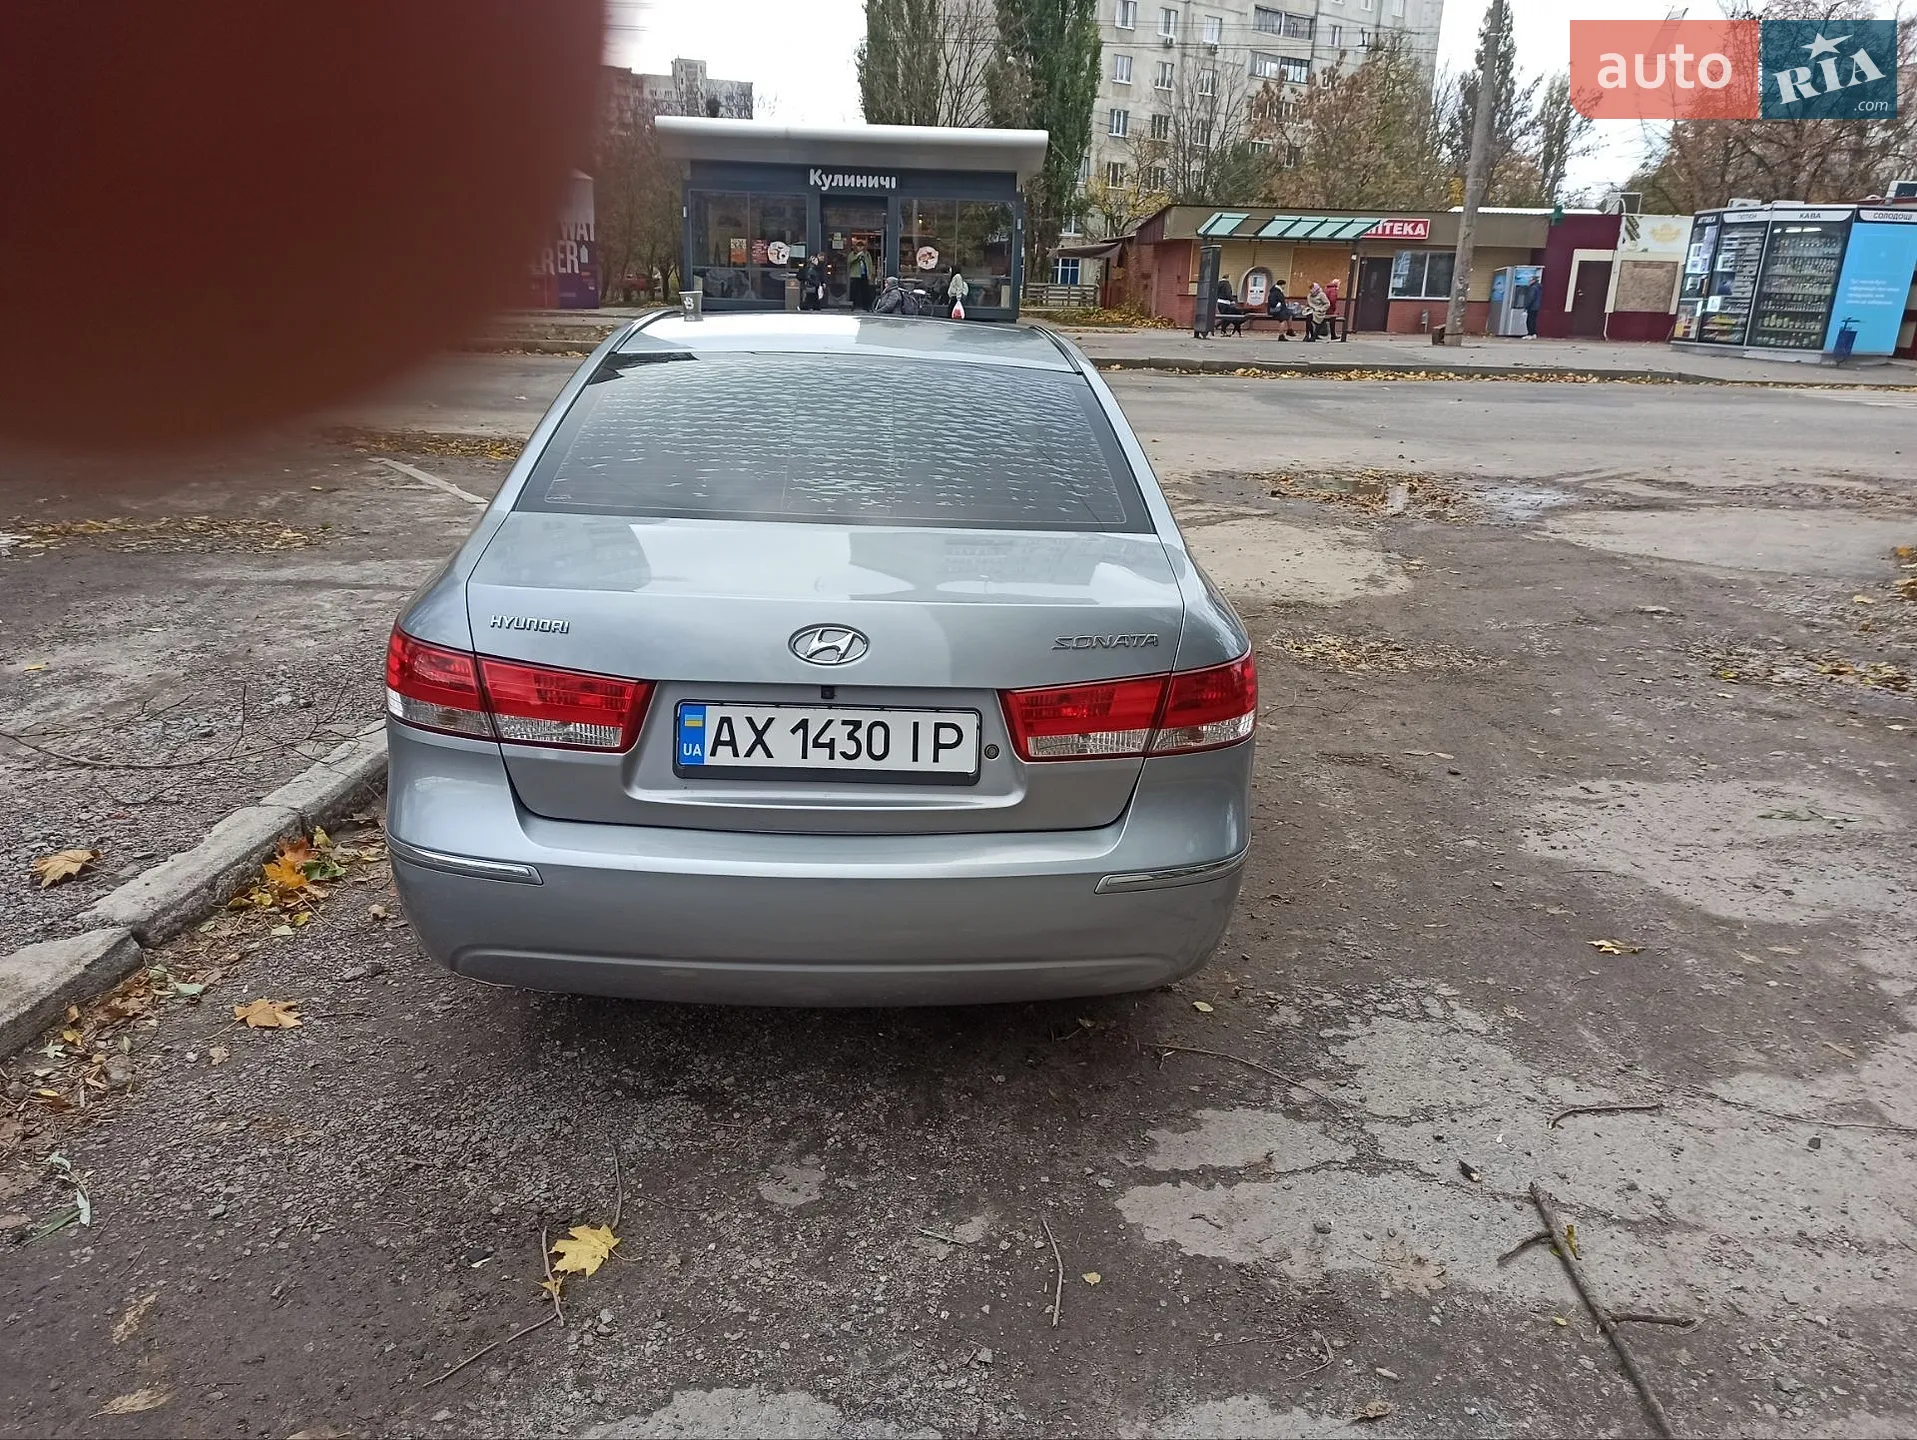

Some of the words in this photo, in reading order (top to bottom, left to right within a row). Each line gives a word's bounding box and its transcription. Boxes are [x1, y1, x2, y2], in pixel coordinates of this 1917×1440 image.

[809, 168, 897, 191] Кулиничі
[490, 615, 570, 634] HYUNDAI
[1051, 633, 1159, 650] SONATA
[683, 742, 702, 756] UA
[709, 716, 776, 759] AX
[789, 717, 891, 762] 1430
[911, 720, 965, 764] IP
